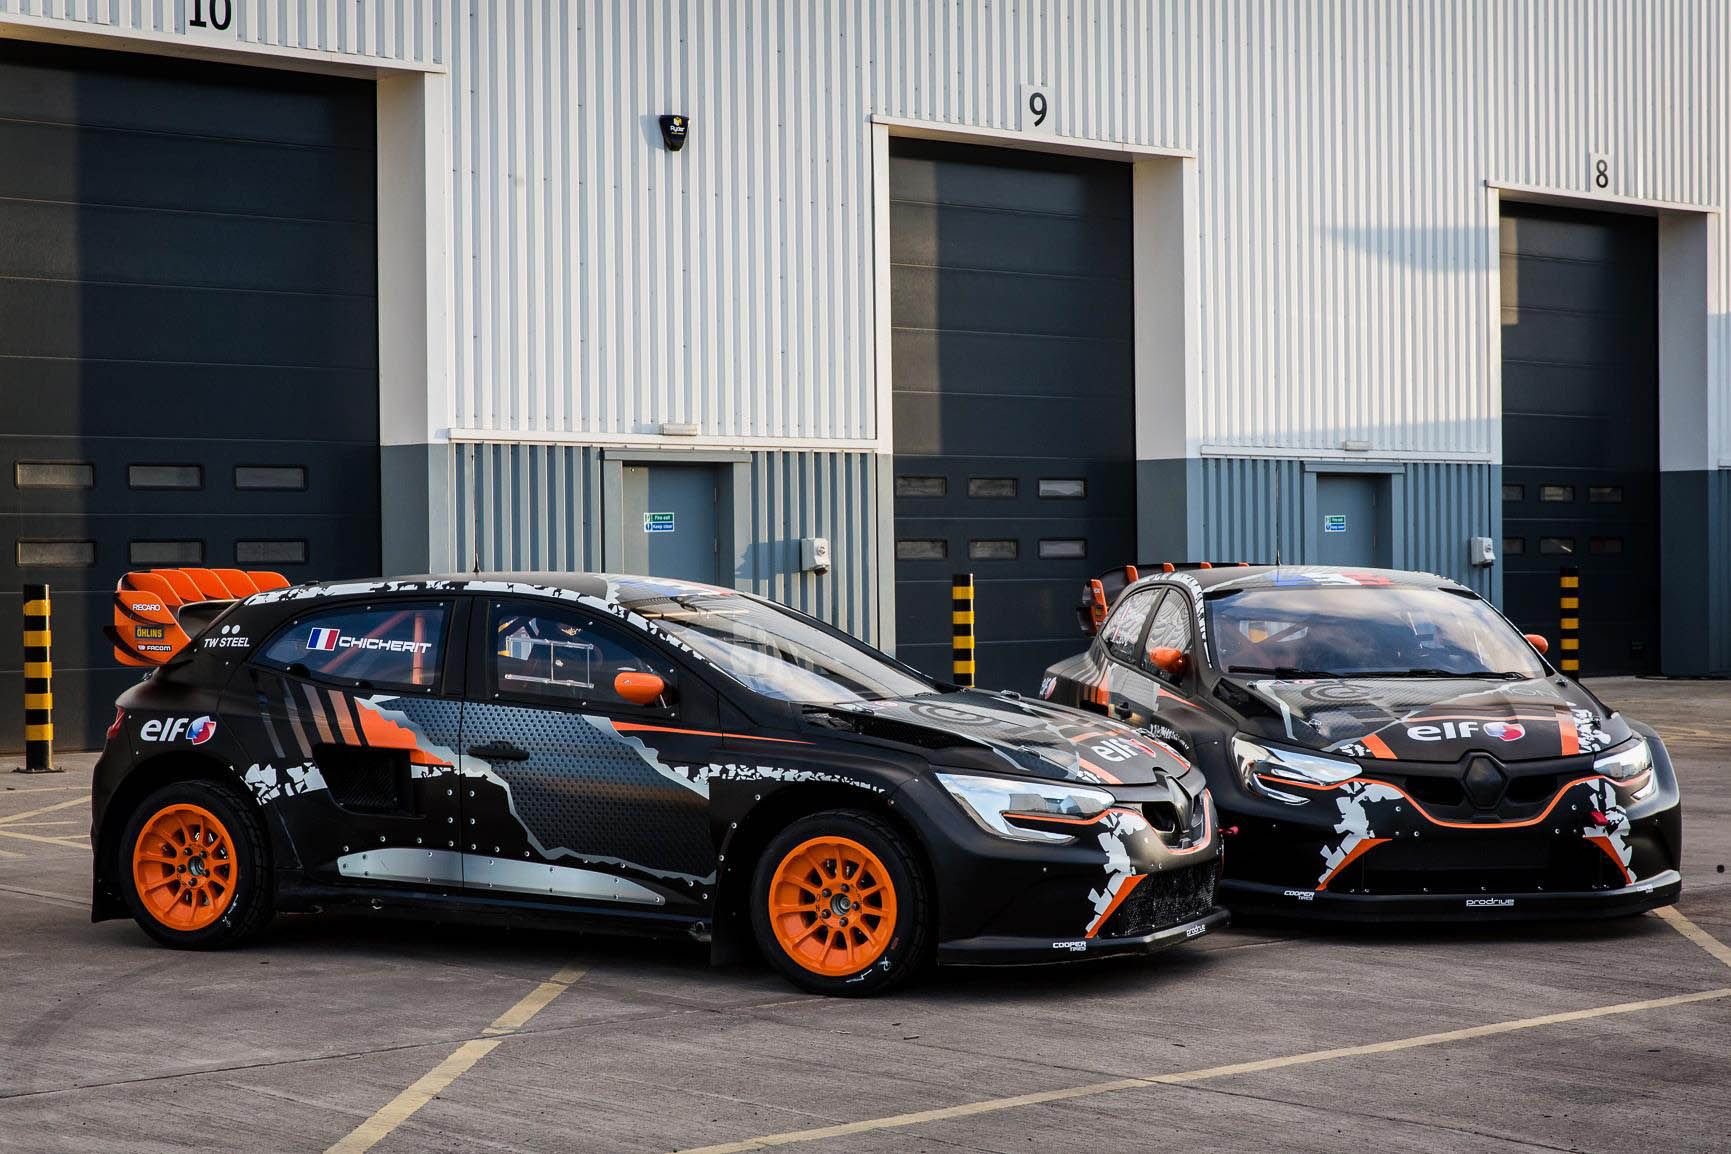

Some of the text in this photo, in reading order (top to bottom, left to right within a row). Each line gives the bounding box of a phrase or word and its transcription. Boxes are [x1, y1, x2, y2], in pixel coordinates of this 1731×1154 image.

[188, 0, 232, 31] 10
[1029, 92, 1047, 127] 9
[1595, 159, 1609, 188] 8
[132, 603, 161, 612] RECARO
[203, 636, 250, 649] TW STEEL
[338, 636, 433, 654] CHICHERIT
[140, 717, 190, 742] elf
[1406, 721, 1480, 742] elf
[1052, 941, 1087, 949] COOPER
